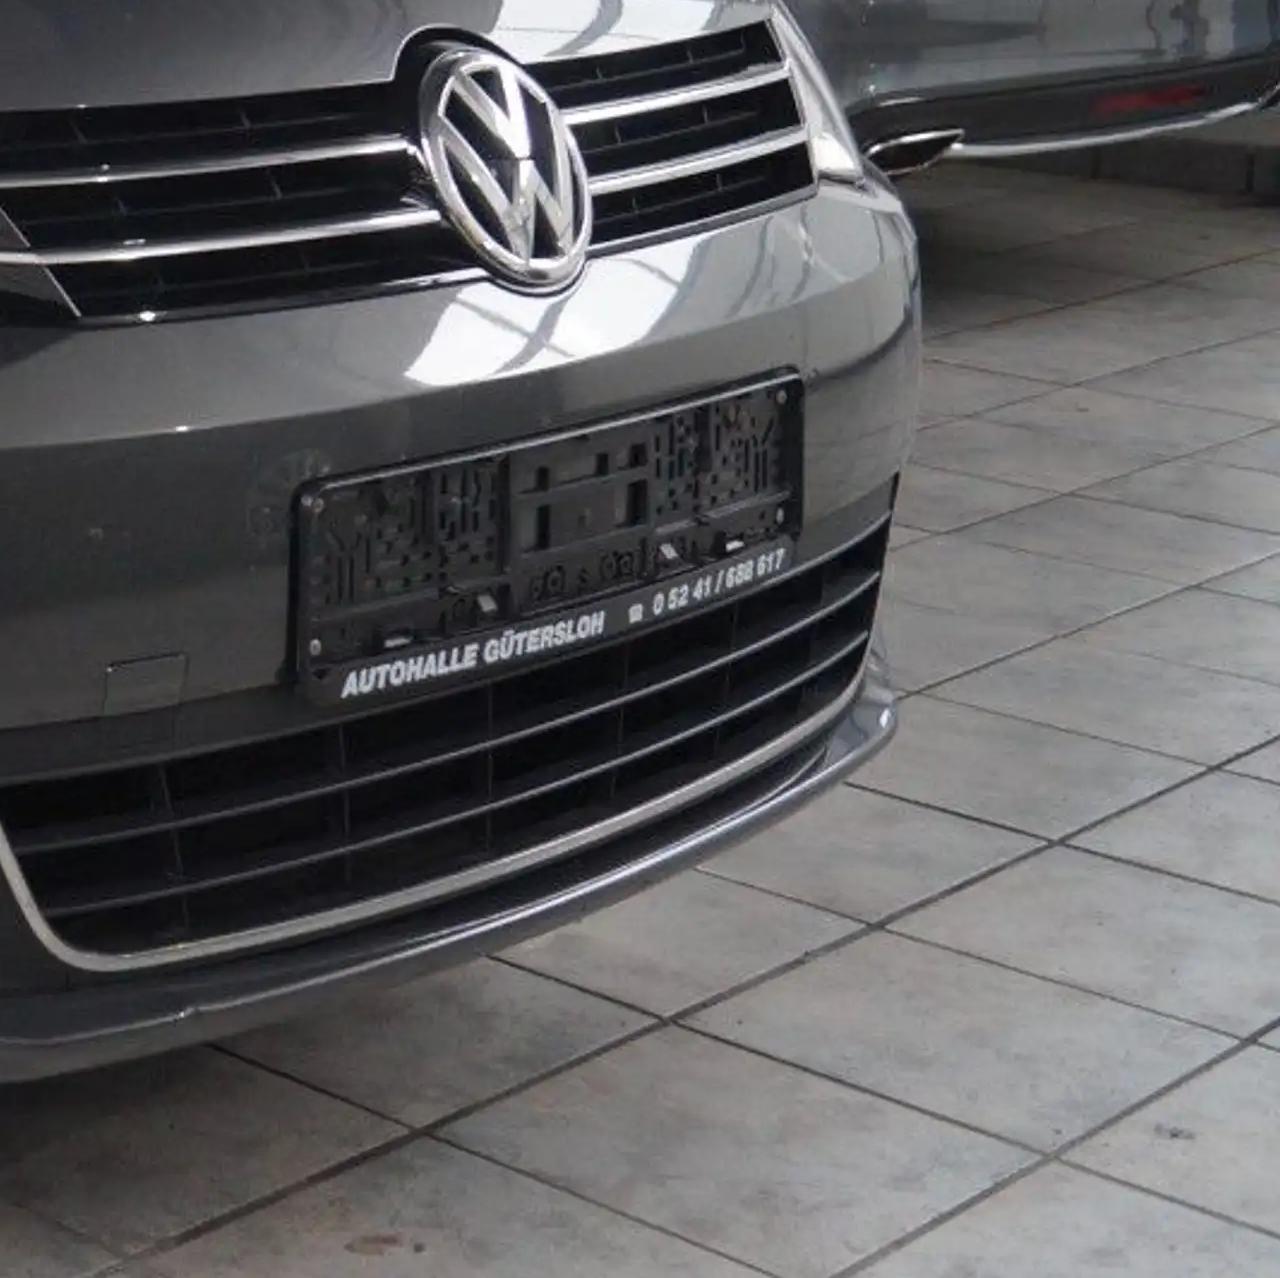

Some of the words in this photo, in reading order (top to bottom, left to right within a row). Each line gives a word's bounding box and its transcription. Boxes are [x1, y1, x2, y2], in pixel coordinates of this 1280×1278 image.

[341, 643, 479, 699] AUTOHALLE
[483, 610, 605, 664] GÜTERSLOH
[692, 575, 713, 601] 41
[757, 547, 786, 576] 617
